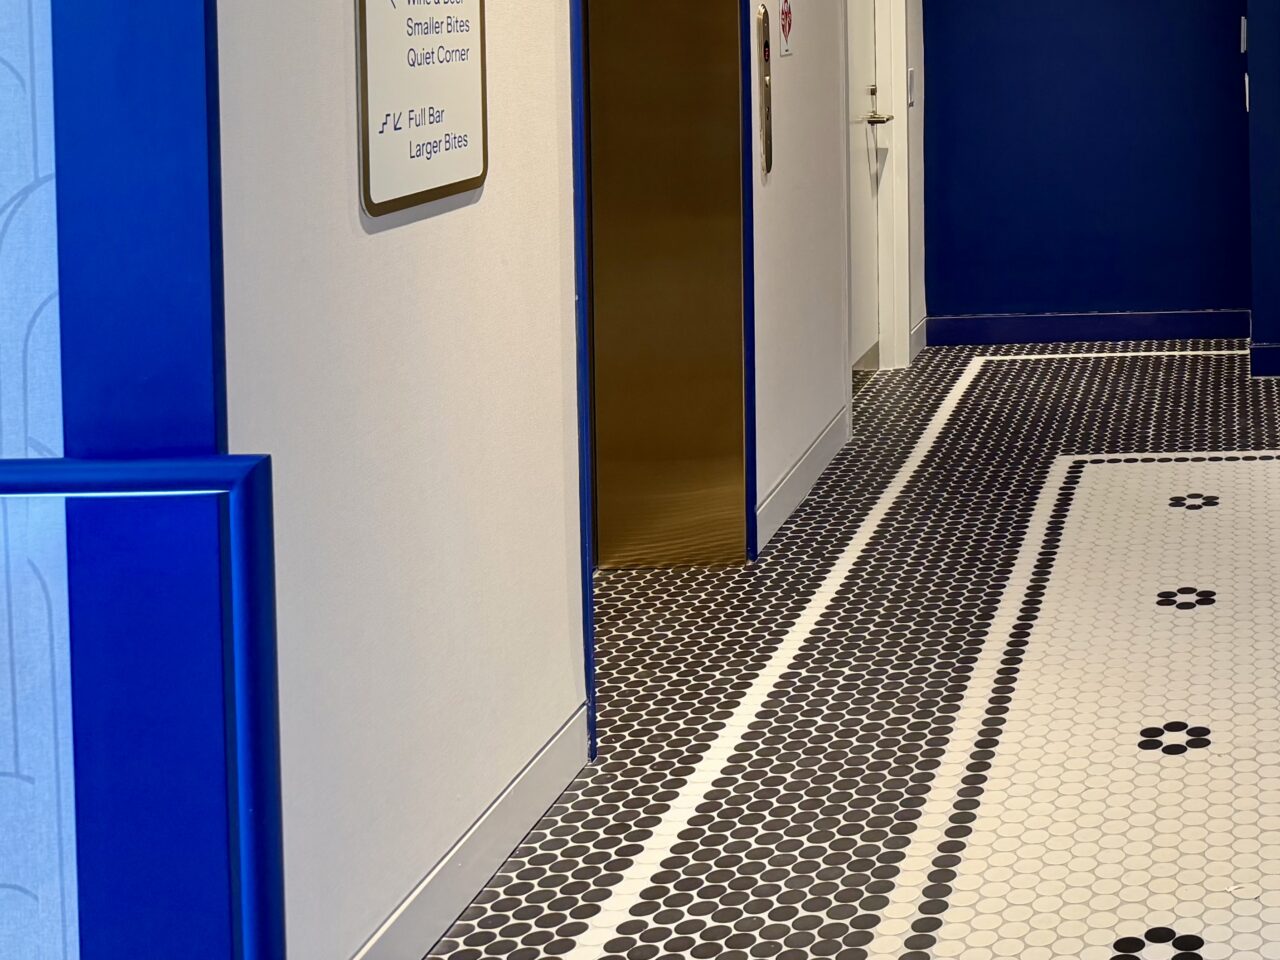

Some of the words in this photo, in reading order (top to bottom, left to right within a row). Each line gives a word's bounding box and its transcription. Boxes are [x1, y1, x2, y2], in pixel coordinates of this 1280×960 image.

[406, 16, 444, 36] Smaller
[446, 15, 470, 33] Bites
[407, 47, 435, 67] Quiet
[437, 45, 470, 64] Corner
[408, 107, 426, 128] Full
[428, 106, 445, 125] Bar
[409, 139, 442, 161] Larger
[444, 132, 468, 151] Bites
